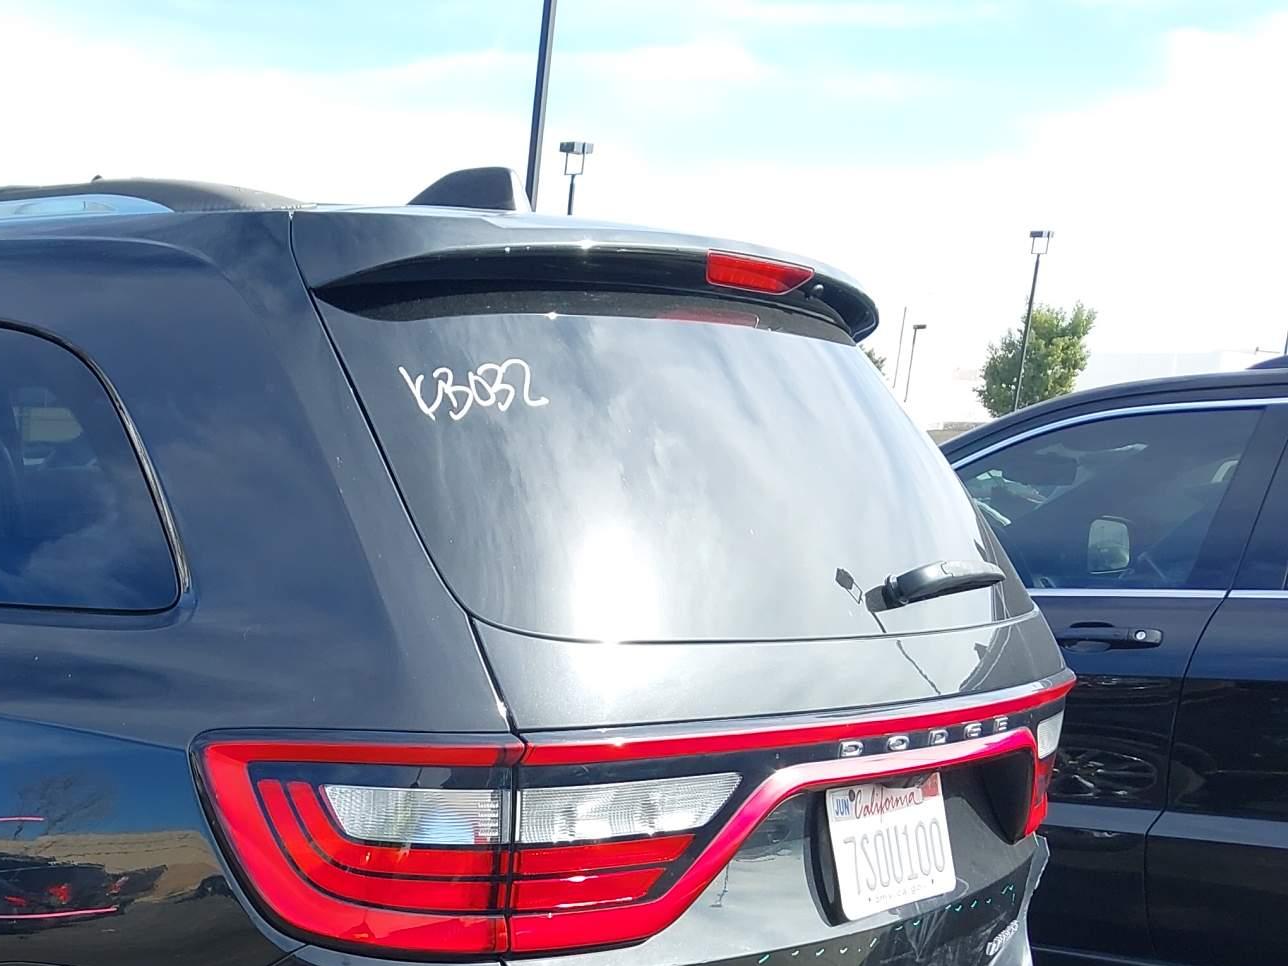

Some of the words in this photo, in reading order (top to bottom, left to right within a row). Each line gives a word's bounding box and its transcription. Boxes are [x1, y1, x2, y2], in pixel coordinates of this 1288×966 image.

[839, 714, 1009, 758] DODGE
[834, 797, 850, 817] JUN
[854, 786, 923, 823] California
